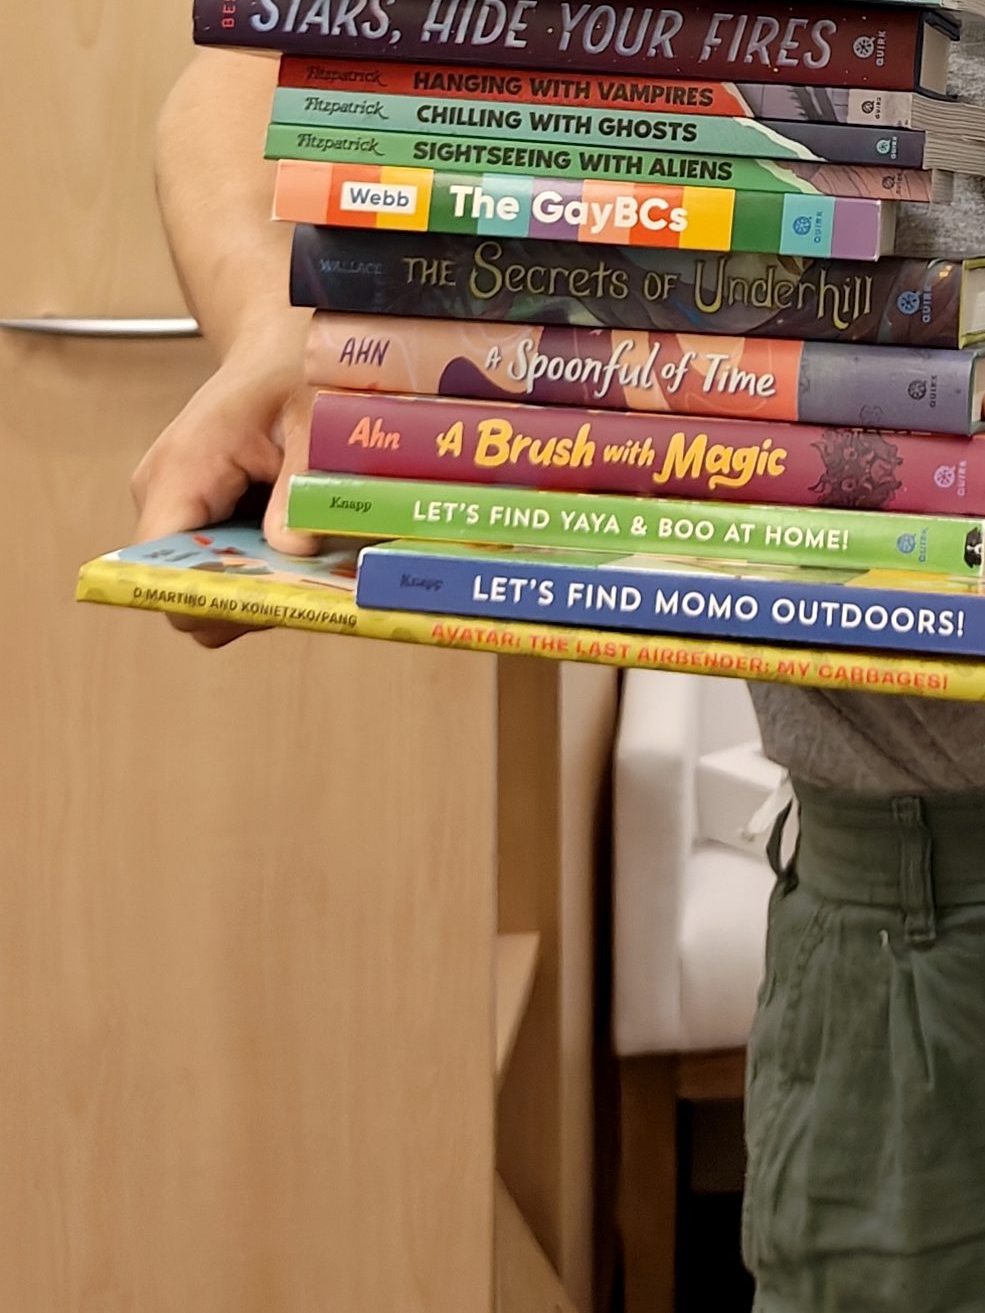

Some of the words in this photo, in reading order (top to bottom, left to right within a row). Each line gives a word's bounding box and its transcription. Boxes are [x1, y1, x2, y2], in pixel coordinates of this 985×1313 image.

[558, 2, 684, 59] YOUR
[700, 14, 838, 69] FIRES
[876, 30, 886, 66] QUIRK
[305, 65, 387, 88] Fitzpatrick
[413, 70, 521, 96] HANGING
[529, 77, 590, 100] WITH
[598, 81, 714, 108] VAMPIRES
[304, 96, 389, 120] Fitzpatrick
[416, 104, 521, 129] CHILLING
[530, 111, 591, 134] WITH
[598, 117, 698, 143] GHOSTS
[297, 132, 386, 157] Fitzpatrick
[413, 141, 571, 170] SIGHTSEEING
[578, 153, 642, 175] WITH
[649, 157, 733, 181] ALIENS
[350, 188, 410, 208] Webb
[449, 185, 520, 221] The
[532, 191, 689, 234] GayBCs
[319, 258, 383, 276] WALLACE
[403, 256, 457, 287] THE
[468, 240, 630, 300] Secrets
[644, 275, 679, 299] OF
[694, 258, 873, 331] Underhill
[339, 336, 391, 367] AHN
[485, 346, 502, 370] A
[506, 337, 655, 398] Spoonful
[661, 353, 695, 393] of
[701, 354, 777, 397] Time
[348, 416, 401, 451] Ahn
[435, 421, 465, 458] A
[473, 418, 596, 469] Brush
[602, 436, 655, 468] with
[652, 432, 788, 490] Magic
[957, 459, 968, 497] QUIRK
[329, 495, 372, 513] Knapp
[413, 500, 480, 525] LET'S
[488, 506, 551, 530] FIND
[561, 510, 621, 534] YAYA
[630, 516, 648, 535] &
[657, 518, 715, 541] BOO
[723, 522, 755, 544] AT
[765, 525, 849, 551] HOME!
[209, 597, 238, 612] AND
[473, 574, 554, 606] LET'S
[567, 582, 642, 612] FIND
[654, 589, 759, 621] MOMO
[772, 598, 966, 638] OUTDOORS!
[431, 622, 521, 649] AVATAR:
[530, 635, 570, 654] THE
[575, 641, 630, 661] LAST
[637, 647, 770, 675] AIRBENDER:
[777, 660, 809, 677] MY
[818, 664, 949, 690] CABBAGES!
